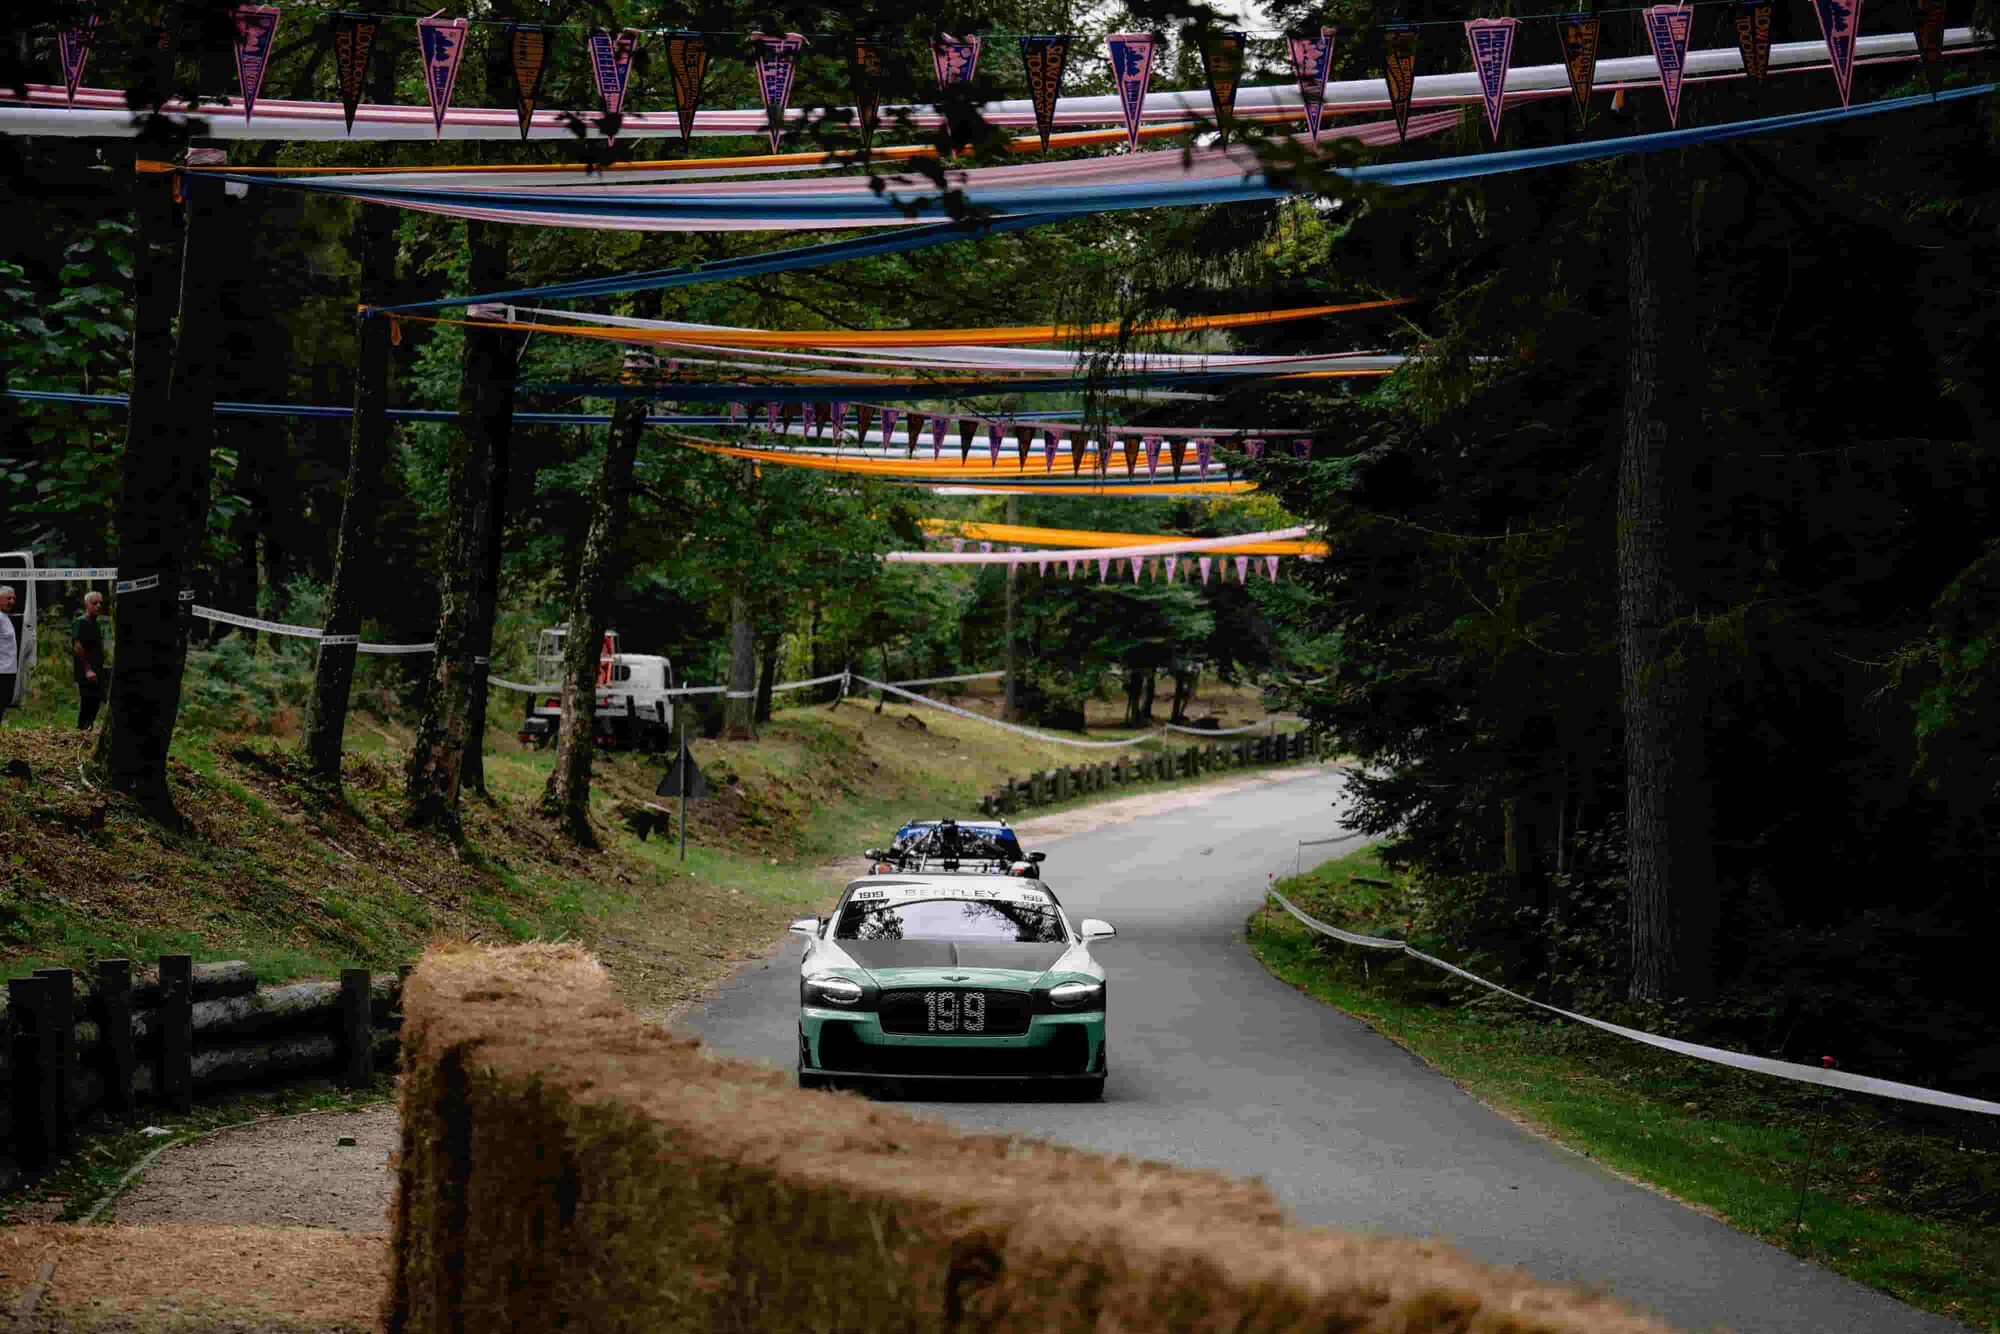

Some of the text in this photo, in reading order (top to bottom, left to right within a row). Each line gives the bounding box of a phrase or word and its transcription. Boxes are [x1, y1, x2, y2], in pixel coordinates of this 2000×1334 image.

[857, 890, 884, 899] 1919
[904, 888, 1000, 898] BENTLEY
[924, 991, 986, 1031] 199
